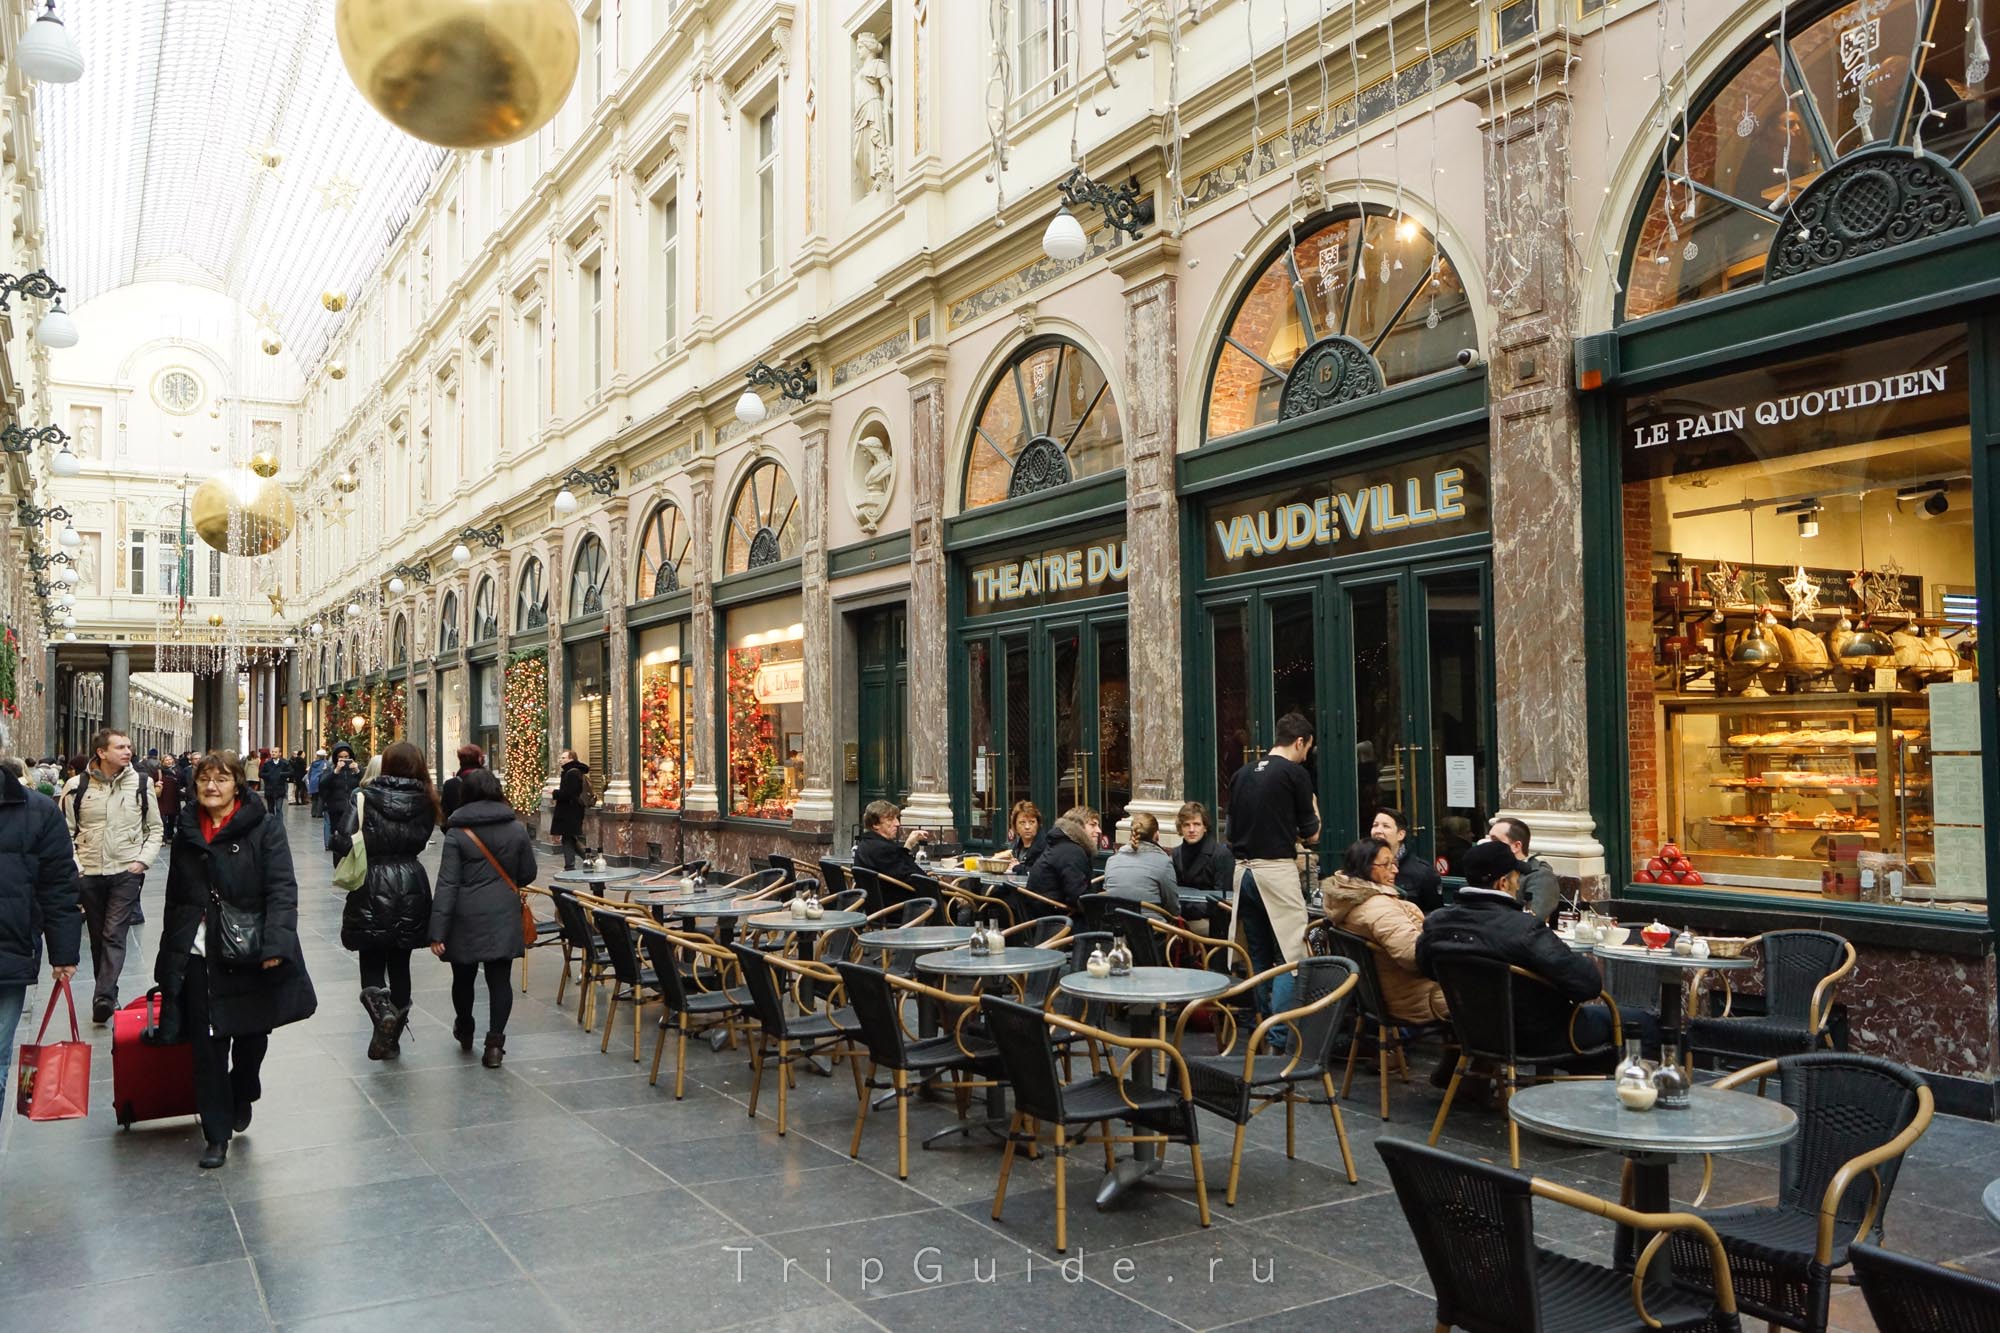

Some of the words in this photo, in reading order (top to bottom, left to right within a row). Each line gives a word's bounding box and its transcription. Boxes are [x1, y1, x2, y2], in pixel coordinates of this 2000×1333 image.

[1319, 364, 1332, 384] 13
[1634, 422, 1669, 449] LE
[1676, 407, 1746, 440] PAIN
[1754, 365, 1948, 425] QUOTIDIEN
[1215, 467, 1466, 562] VAUDEVILLE
[972, 550, 1083, 603] THEATRE
[1087, 540, 1129, 584] DU
